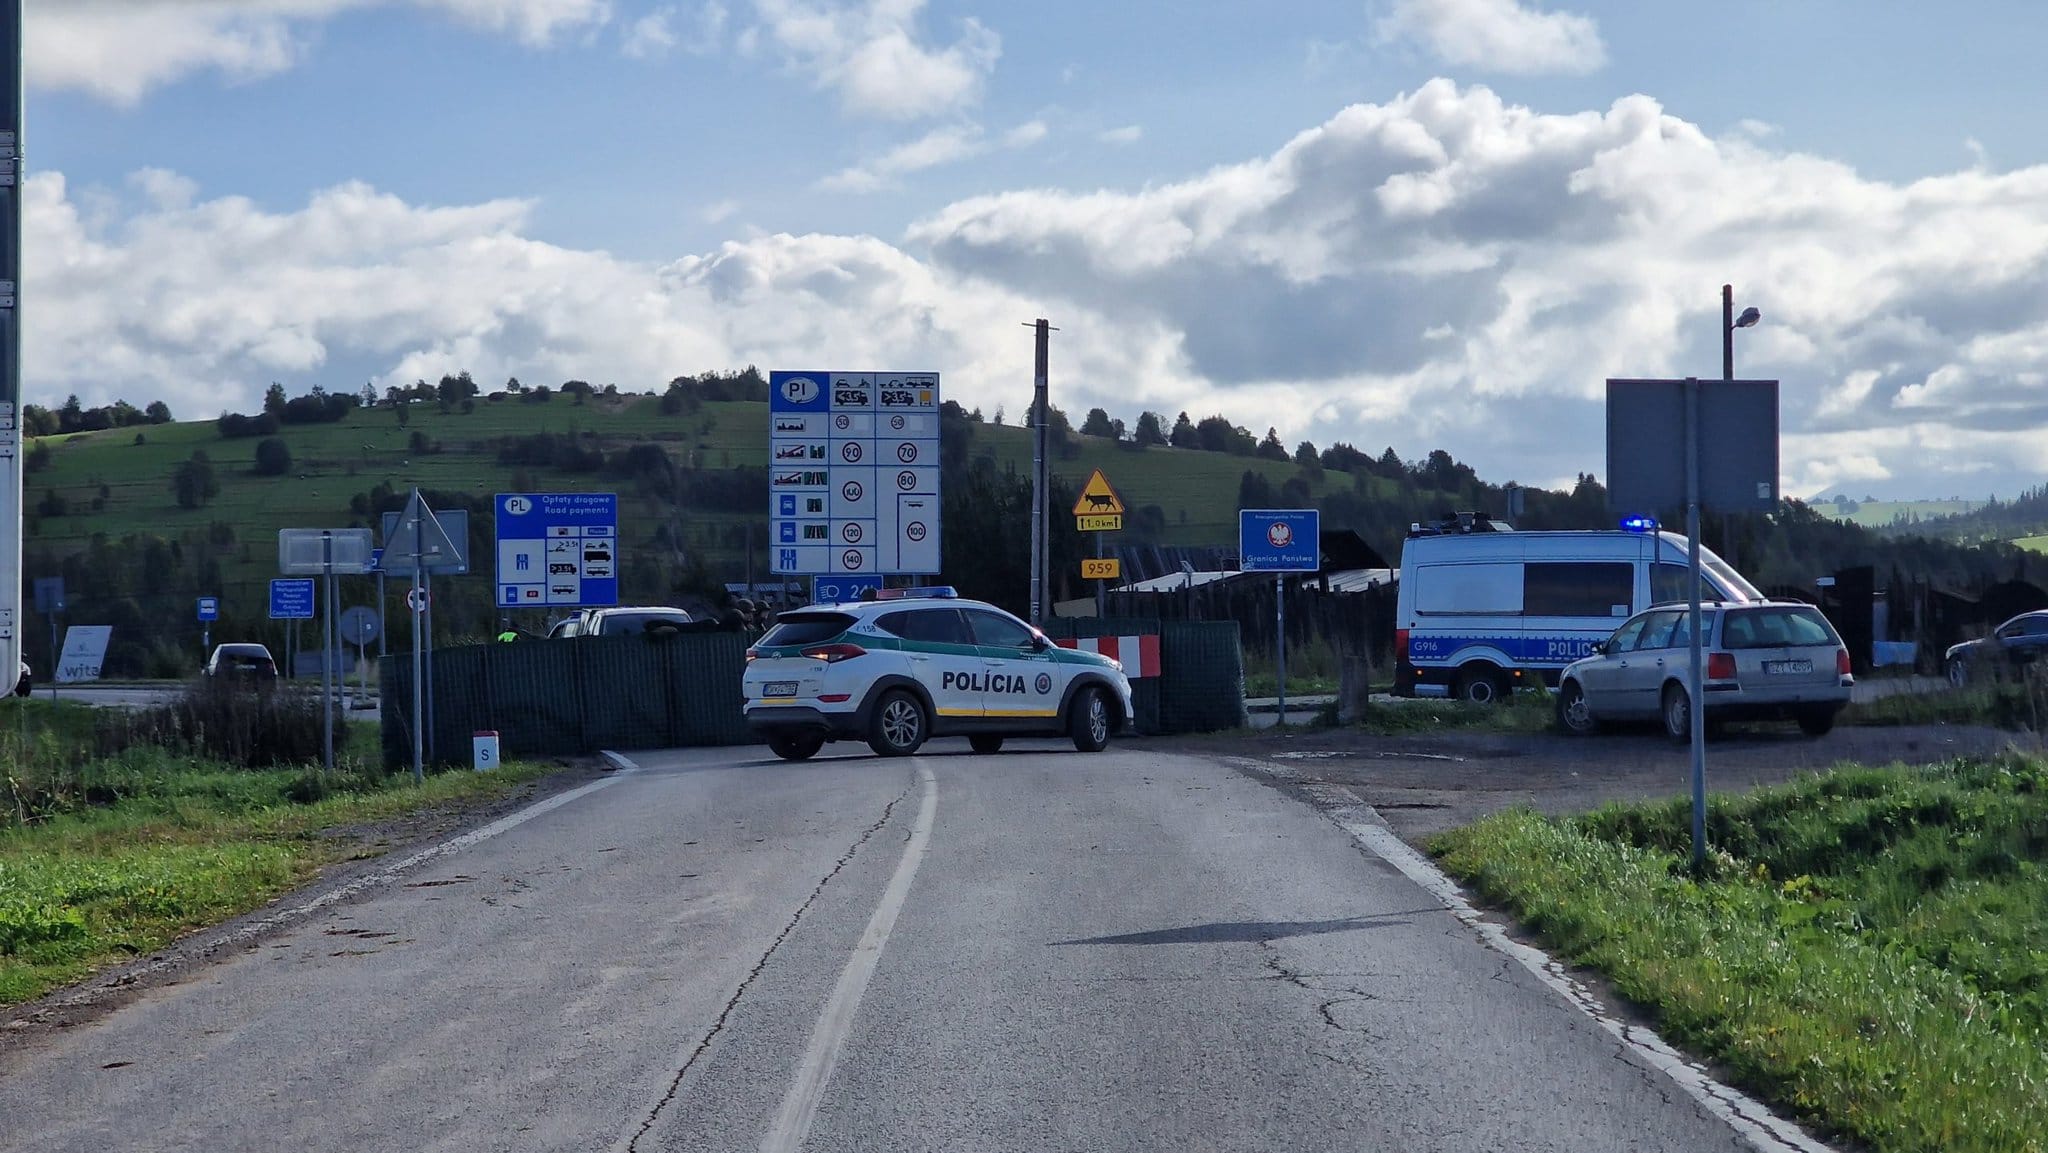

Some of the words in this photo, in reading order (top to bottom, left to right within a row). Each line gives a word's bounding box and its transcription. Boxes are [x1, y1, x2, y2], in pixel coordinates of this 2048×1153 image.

[845, 447, 859, 458] 90
[901, 447, 913, 458] 70
[900, 475, 913, 485] 80
[845, 486, 861, 497] 100
[510, 499, 526, 512] PL
[544, 505, 567, 514] Road
[569, 505, 609, 516] payments
[845, 528, 860, 538] 120
[909, 527, 924, 537] 100
[845, 555, 860, 565] 140
[1088, 563, 1113, 575] 959
[863, 624, 877, 633] 158
[1414, 641, 1438, 651] G916
[1548, 641, 1592, 657] POLIC
[942, 669, 1026, 694] POLÍCIA
[481, 748, 490, 761] S
